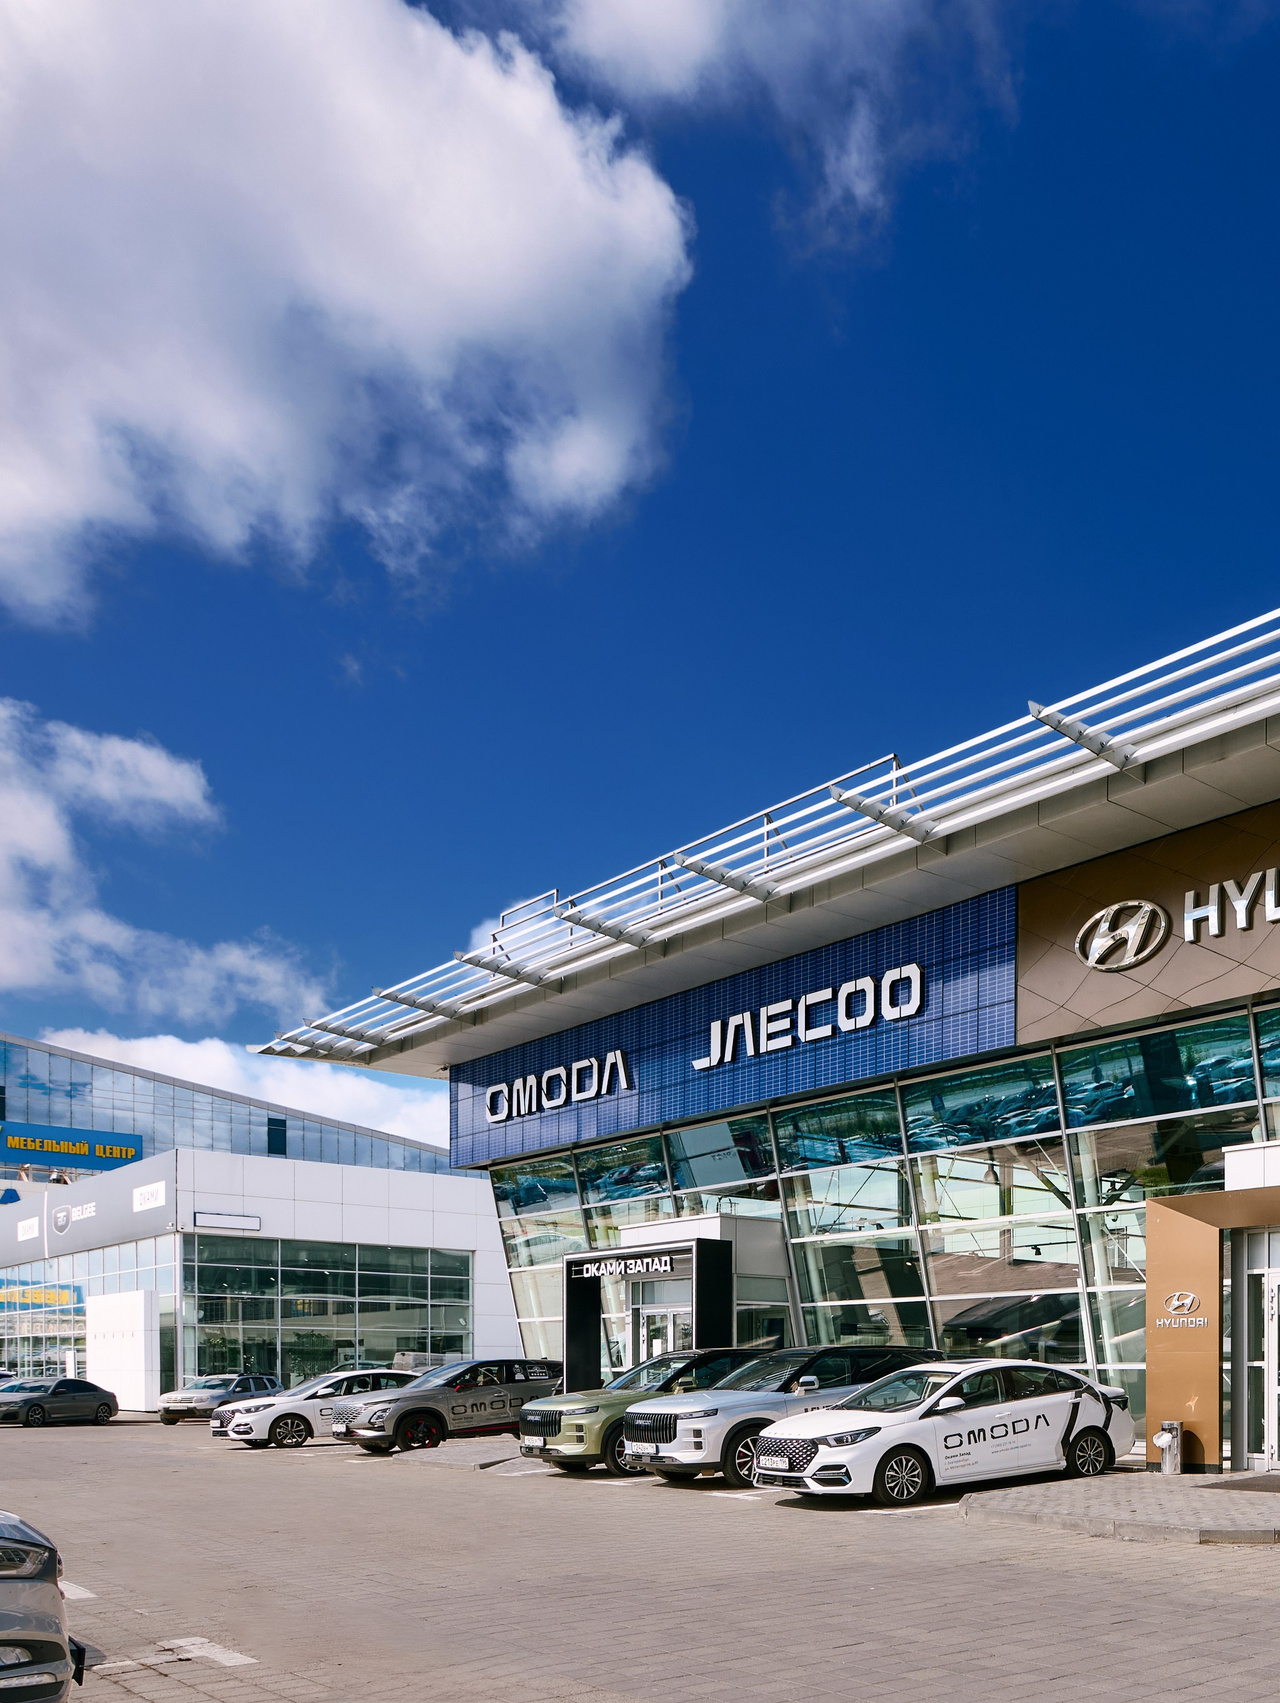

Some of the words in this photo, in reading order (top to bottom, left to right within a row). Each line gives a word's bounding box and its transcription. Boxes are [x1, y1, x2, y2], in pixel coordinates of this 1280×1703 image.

[691, 962, 926, 1071] JAECOO
[485, 1049, 631, 1124] OMODA
[7, 1135, 89, 1155] МЕБЕЛЬНЫЙ
[95, 1144, 136, 1159] ЦЕНТР
[71, 1202, 96, 1222] BELGEE
[583, 1261, 625, 1278] ОКАМИ
[626, 1255, 671, 1274] ЗАПАД
[1156, 1317, 1209, 1328] HYUNDAI
[943, 1413, 1050, 1450] OMODA
